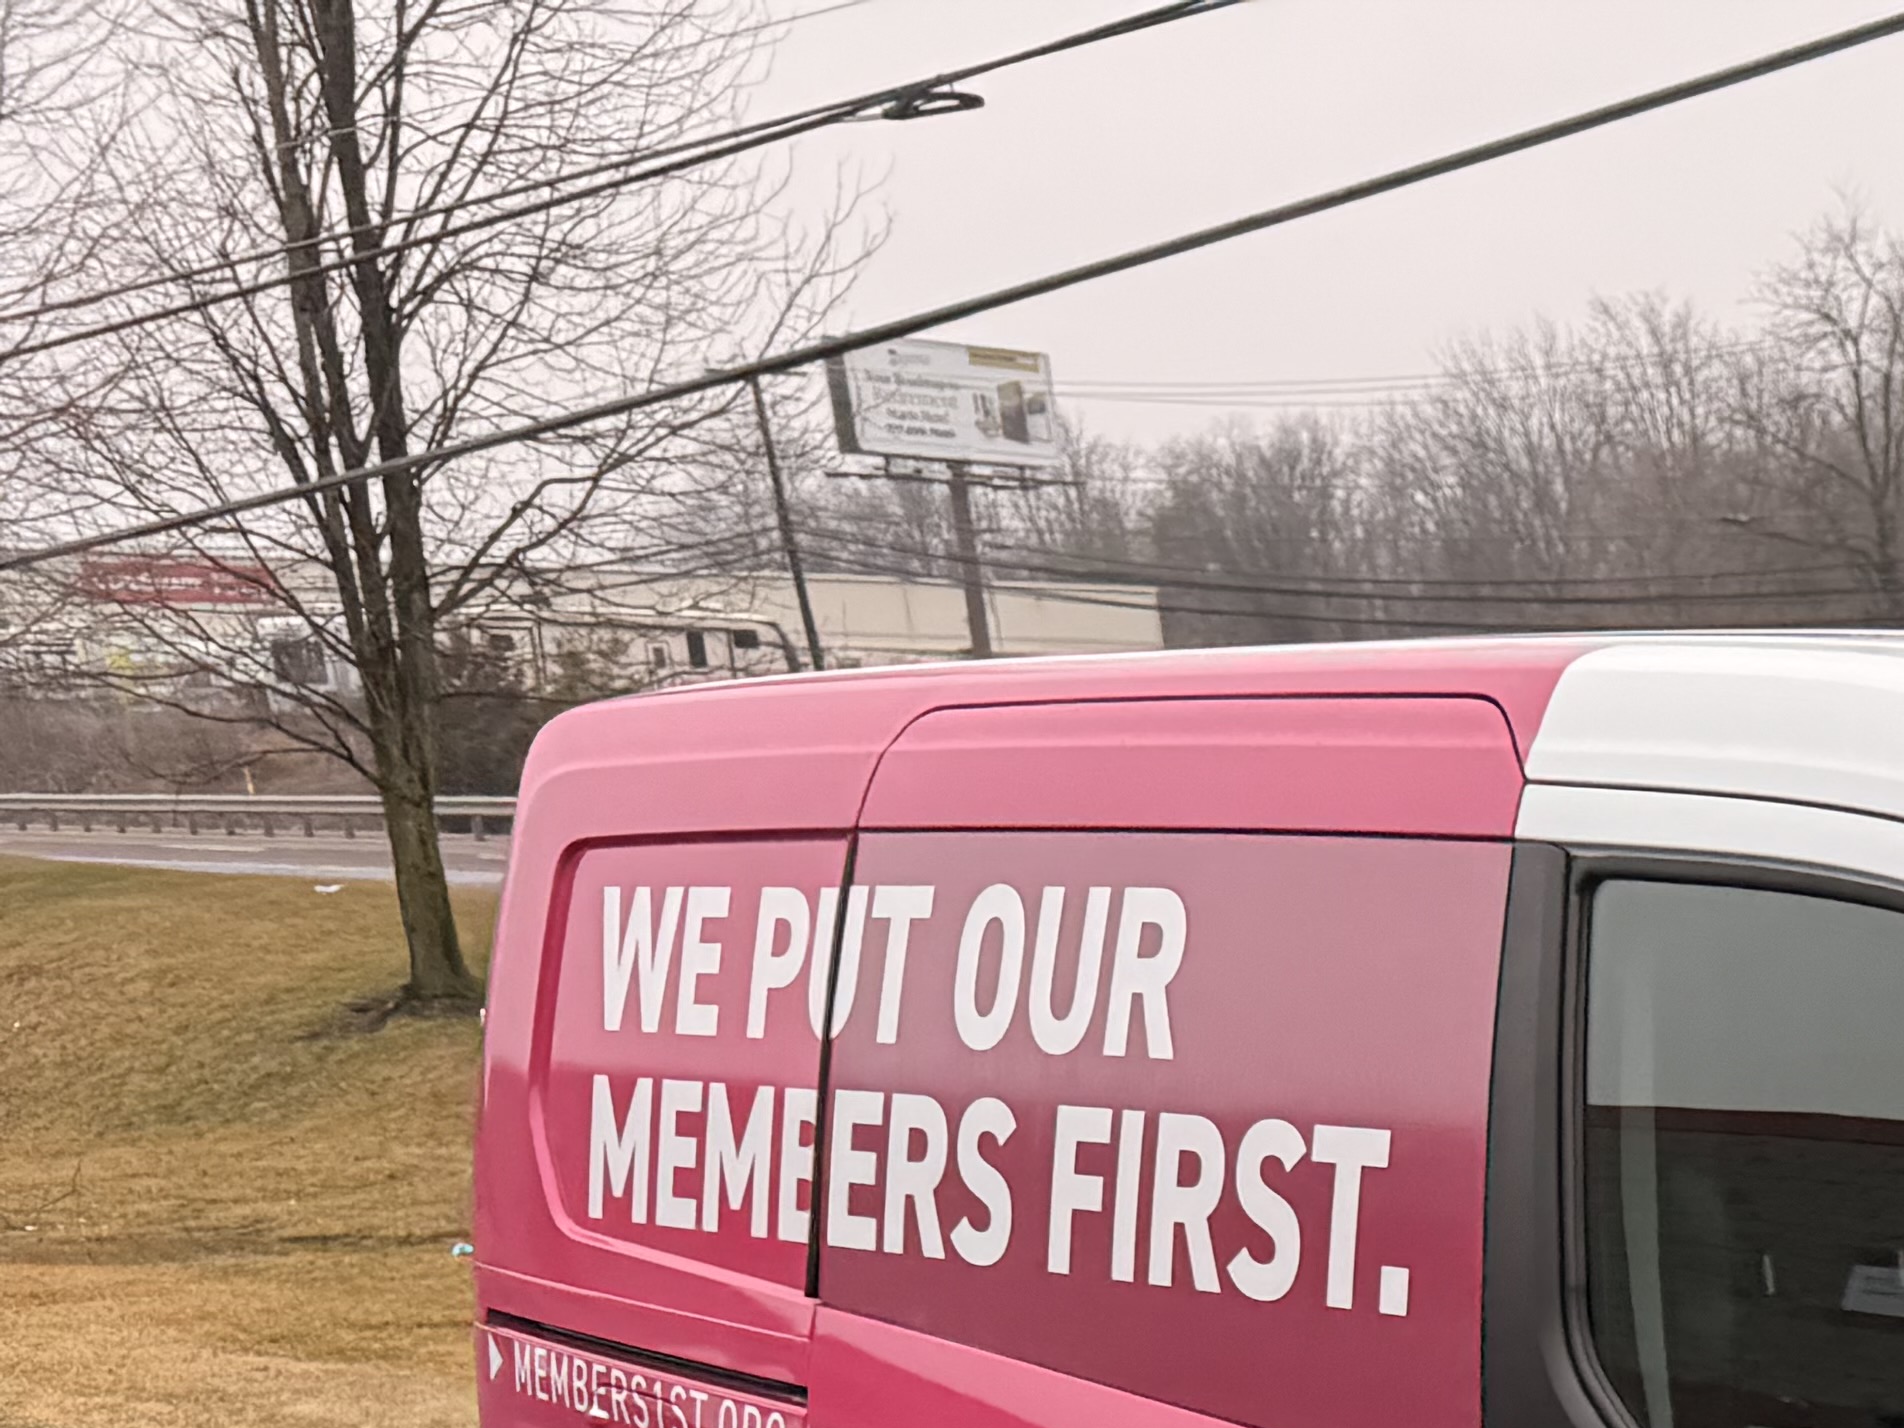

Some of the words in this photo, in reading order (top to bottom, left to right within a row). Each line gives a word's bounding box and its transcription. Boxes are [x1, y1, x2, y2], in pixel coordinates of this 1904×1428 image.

[602, 884, 727, 1036] WE
[745, 883, 936, 1045] PUT
[952, 882, 1187, 1060] OUR
[588, 1074, 1018, 1268] MEMBERS
[1047, 1104, 1411, 1318] FIRST.
